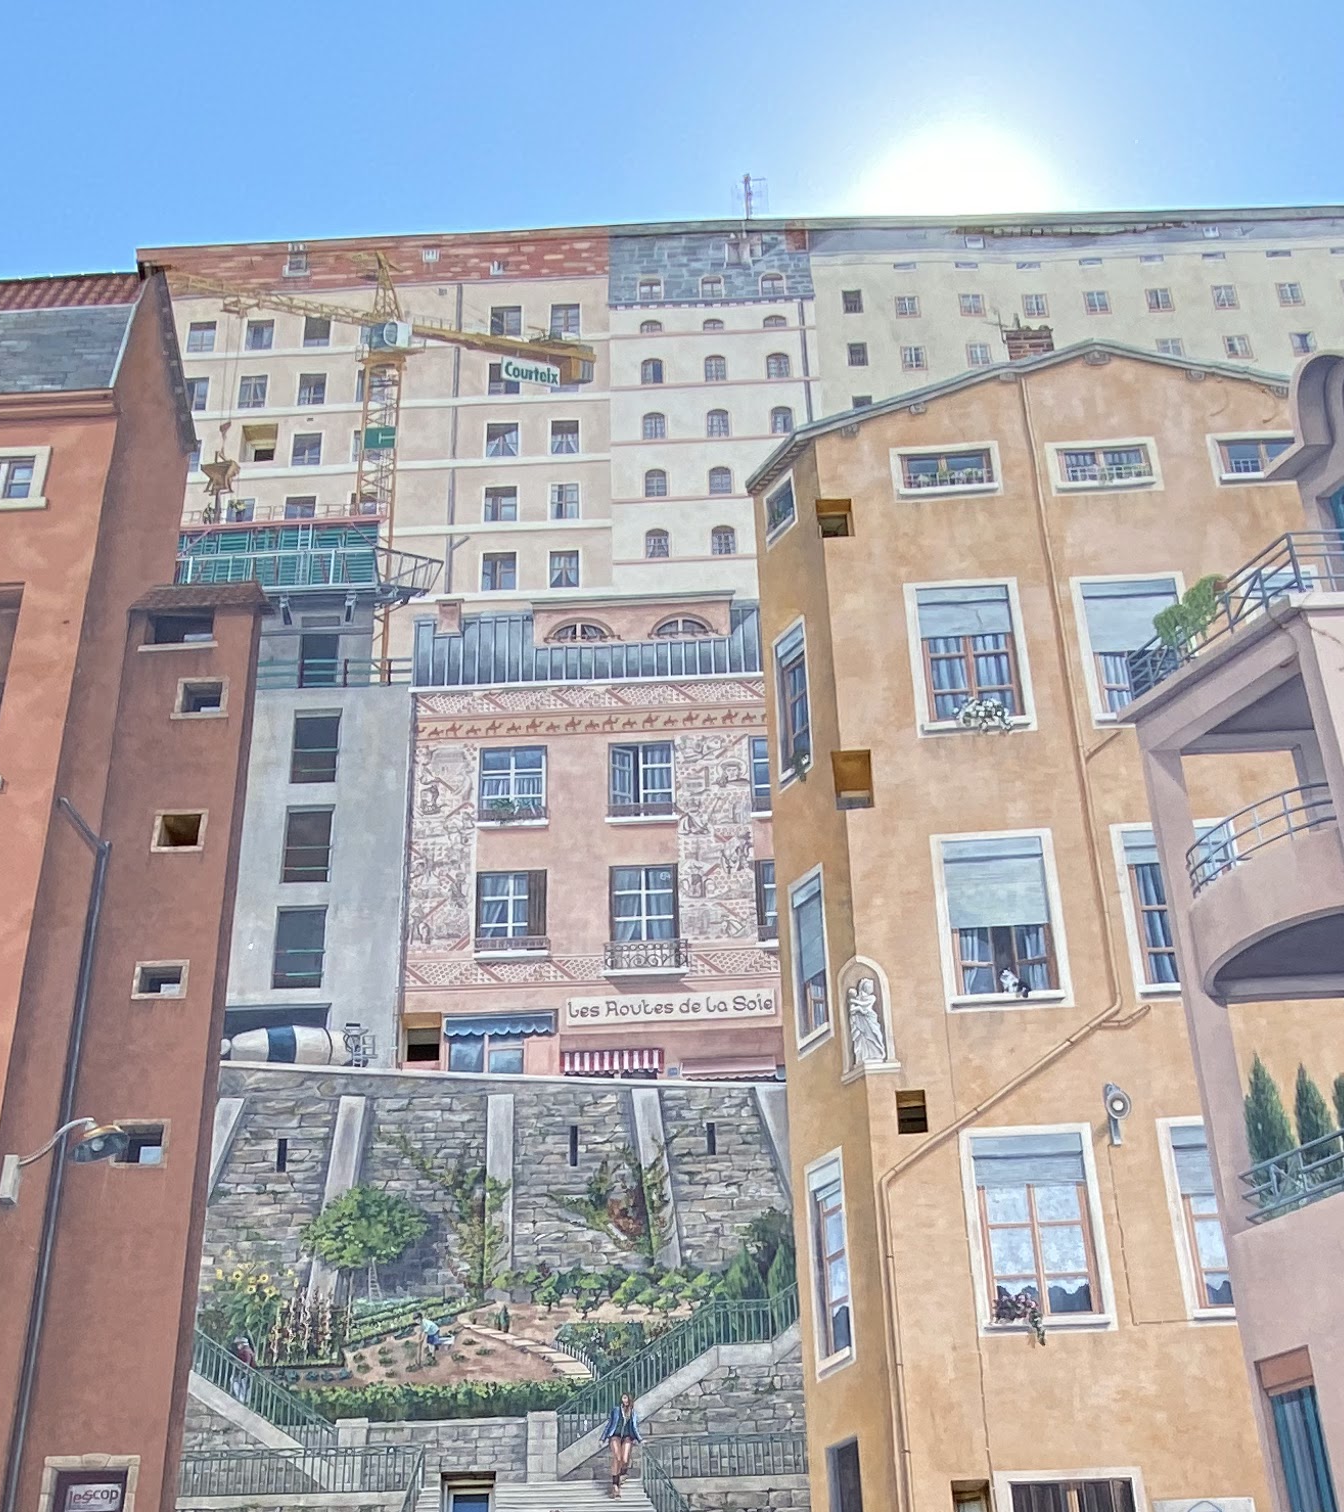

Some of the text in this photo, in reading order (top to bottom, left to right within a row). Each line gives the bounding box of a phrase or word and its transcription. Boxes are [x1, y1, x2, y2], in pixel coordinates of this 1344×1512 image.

[568, 1001, 600, 1019] Les
[605, 1000, 674, 1017] Routes
[679, 998, 702, 1014] de
[732, 994, 773, 1011] Soie
